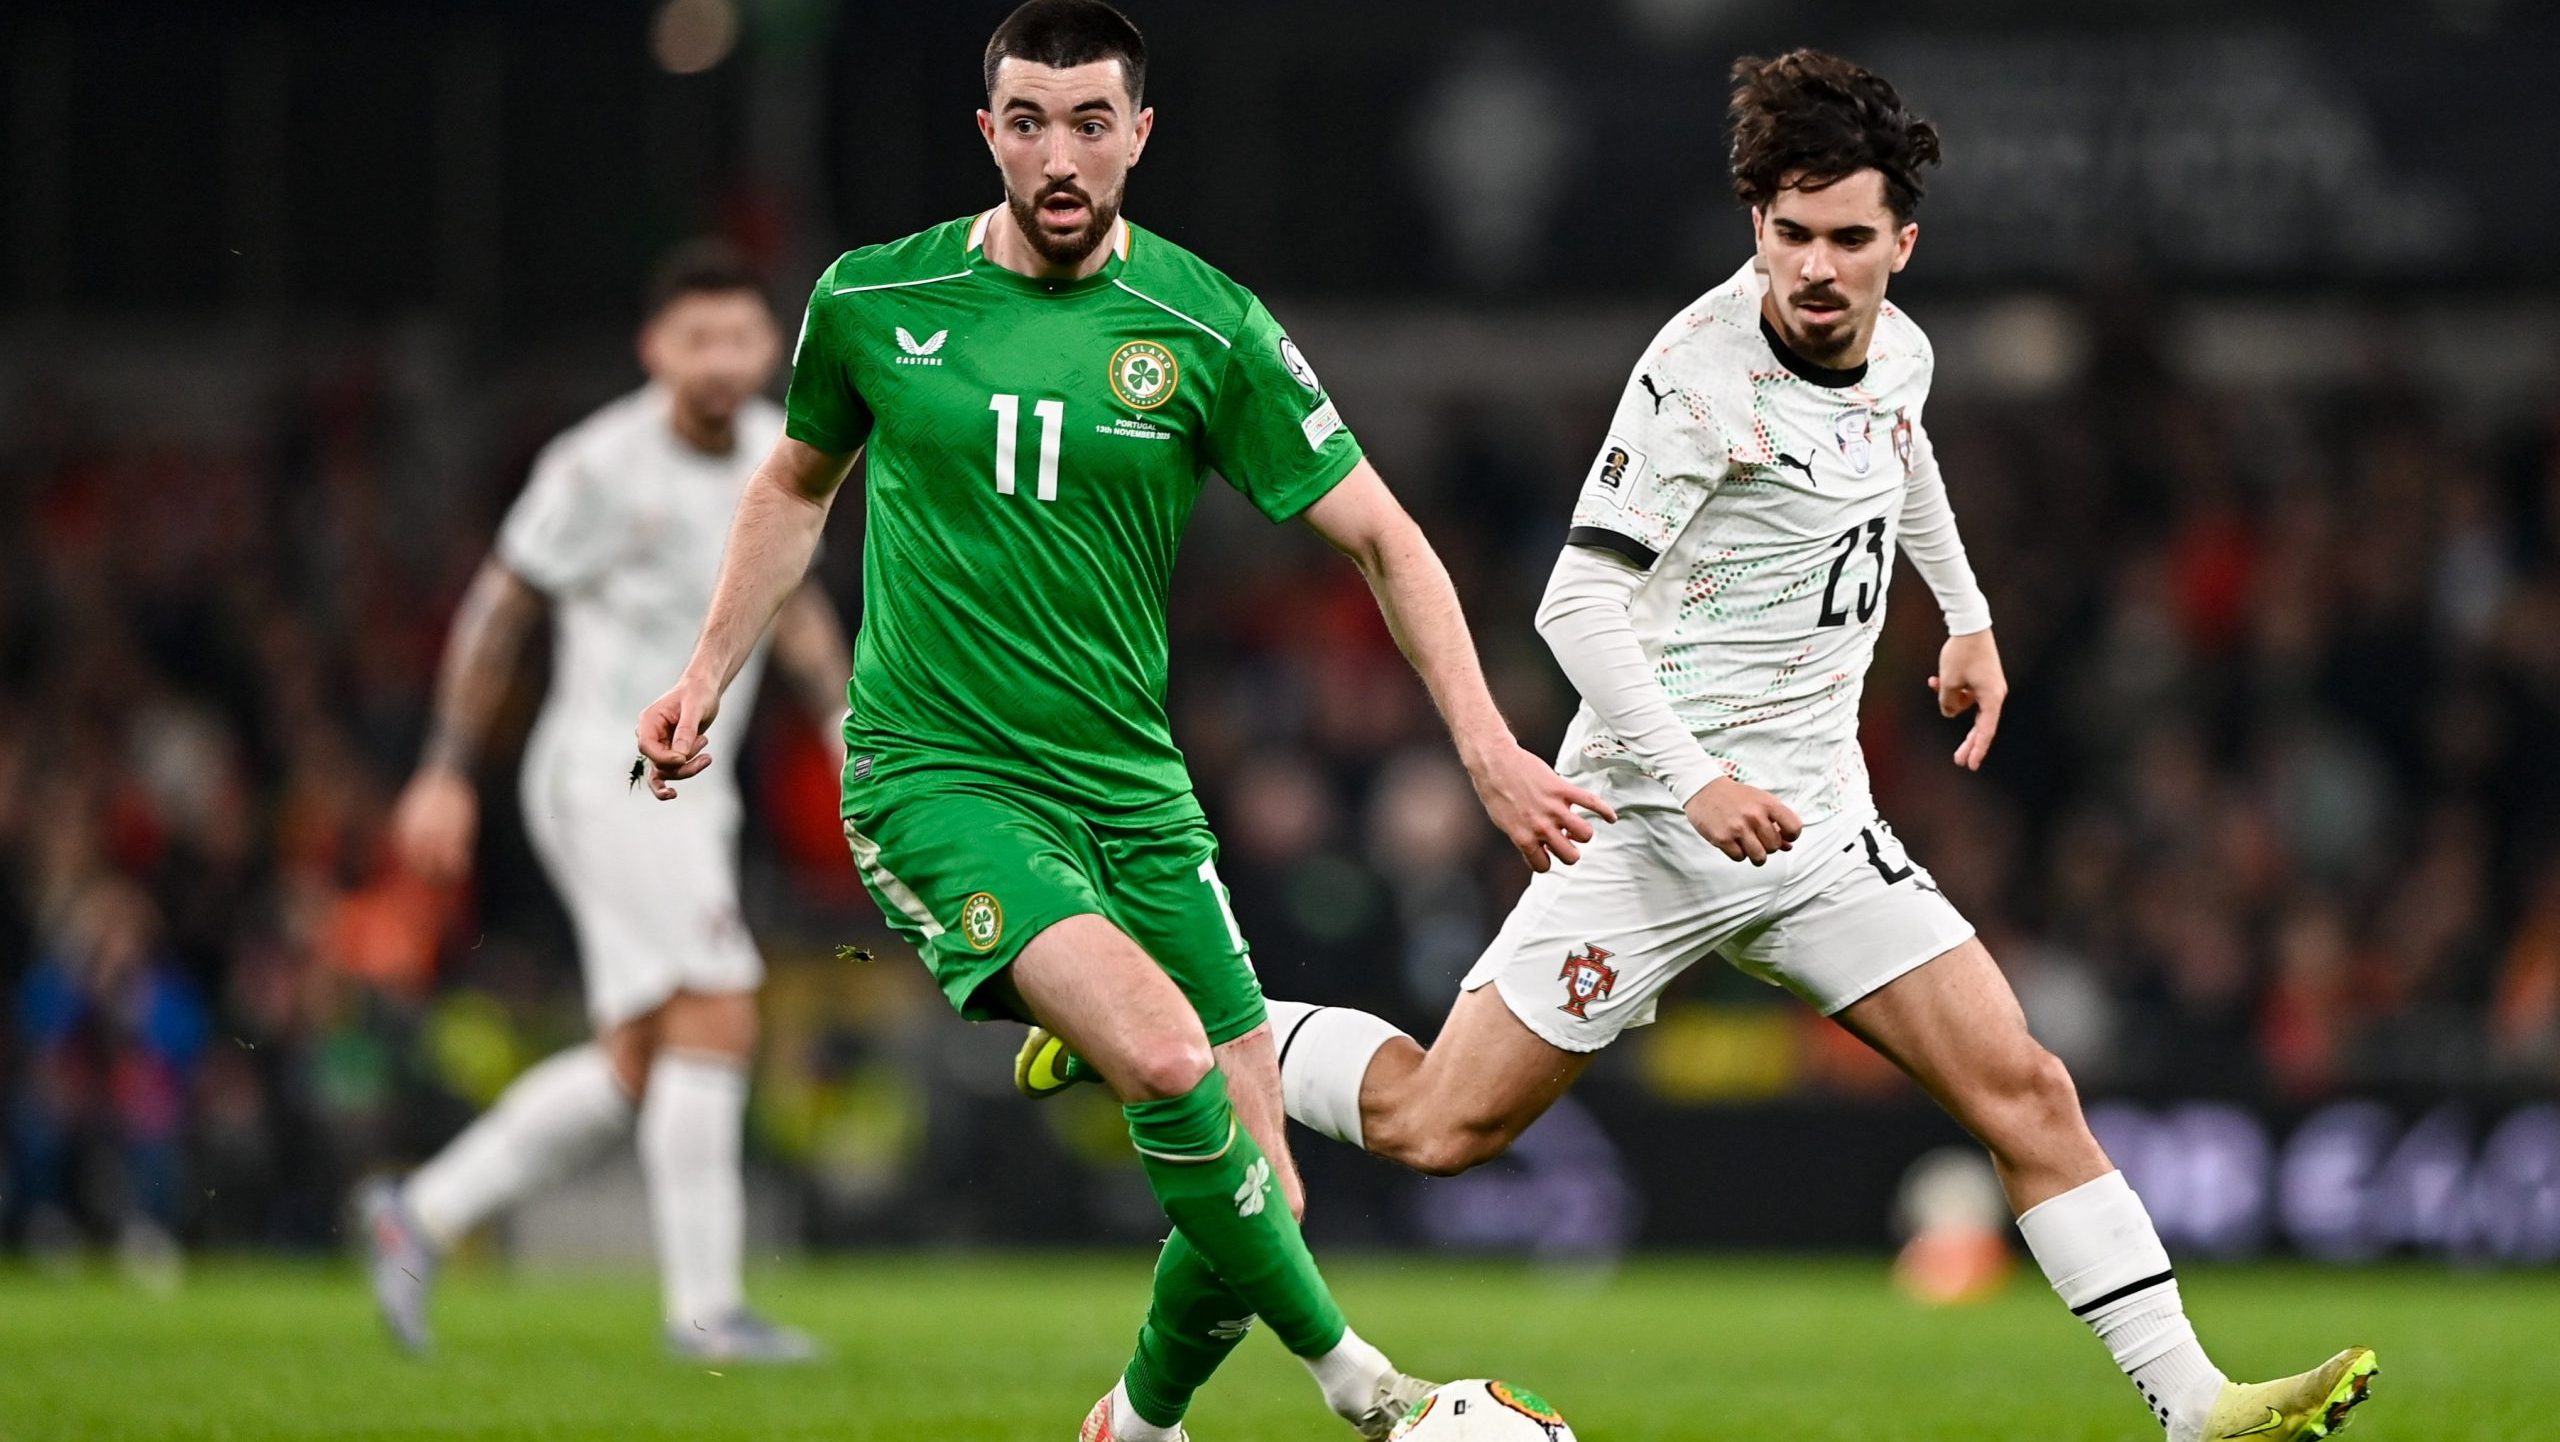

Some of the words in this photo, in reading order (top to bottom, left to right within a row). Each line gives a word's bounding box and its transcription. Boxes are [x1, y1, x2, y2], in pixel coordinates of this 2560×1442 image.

[895, 356, 943, 366] CASTORE
[1118, 345, 1171, 368] IRELAND
[1095, 425, 1113, 434] 13th
[1113, 427, 1156, 440] NOVEMBER
[1115, 419, 1156, 430] PORTUGAL
[988, 393, 1064, 502] 11
[1816, 516, 1887, 628] 23
